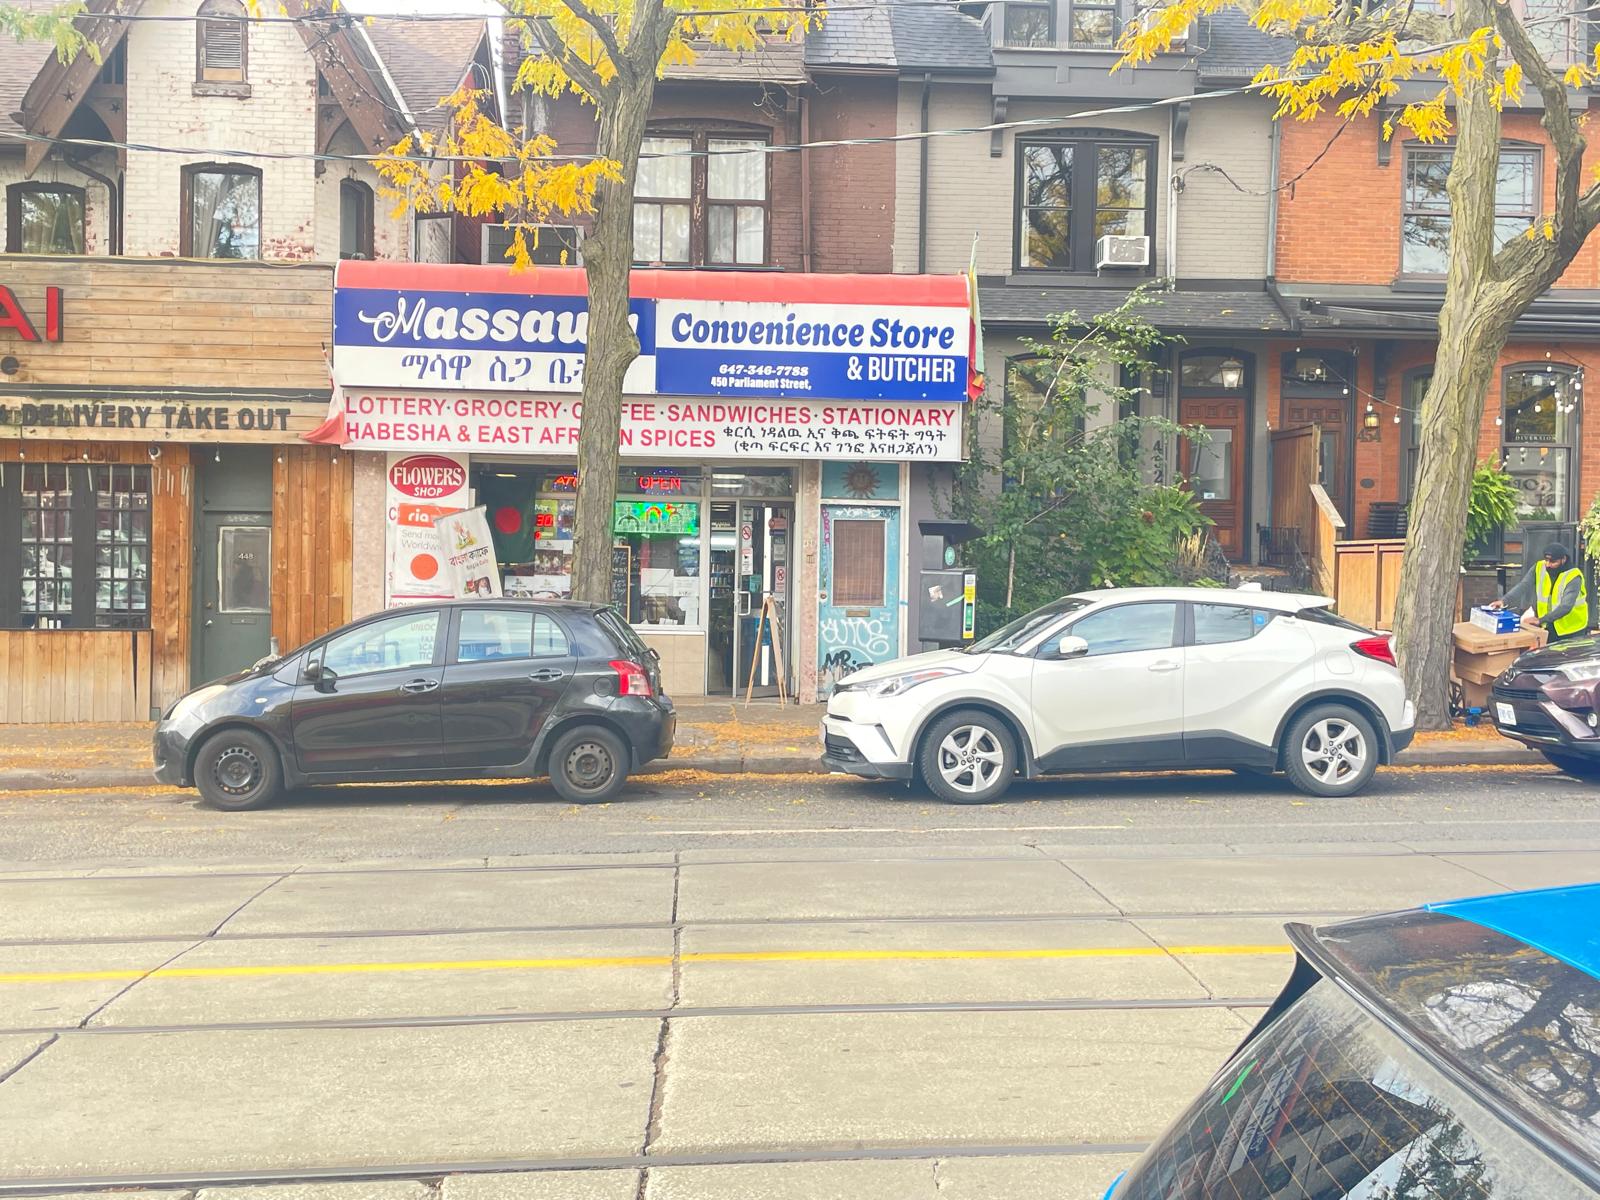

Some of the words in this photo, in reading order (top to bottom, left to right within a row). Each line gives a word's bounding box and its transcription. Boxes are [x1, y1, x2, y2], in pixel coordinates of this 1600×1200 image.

[357, 297, 639, 344] Massaw
[671, 312, 864, 345] Convenience
[869, 318, 955, 349] Store
[719, 364, 809, 376] 647-346-7788
[847, 356, 863, 381] &
[868, 356, 955, 383] BUTCHER
[711, 376, 728, 387] 450
[728, 377, 779, 389] Parliament
[780, 378, 812, 391] Street,
[22, 404, 153, 428] DELIVERY
[161, 406, 229, 430] TAKE
[238, 408, 291, 431] OUT
[345, 397, 446, 416] LOTTERY
[454, 399, 561, 419] GROCERY
[667, 404, 811, 424] SANDWICHES
[822, 407, 956, 427] STATIONARY
[346, 422, 451, 442] HABESHA
[457, 425, 471, 442] &
[478, 426, 533, 444] EAST
[640, 429, 716, 447] SPICES
[393, 467, 462, 486] FLOWERS
[413, 487, 443, 497] SHOP
